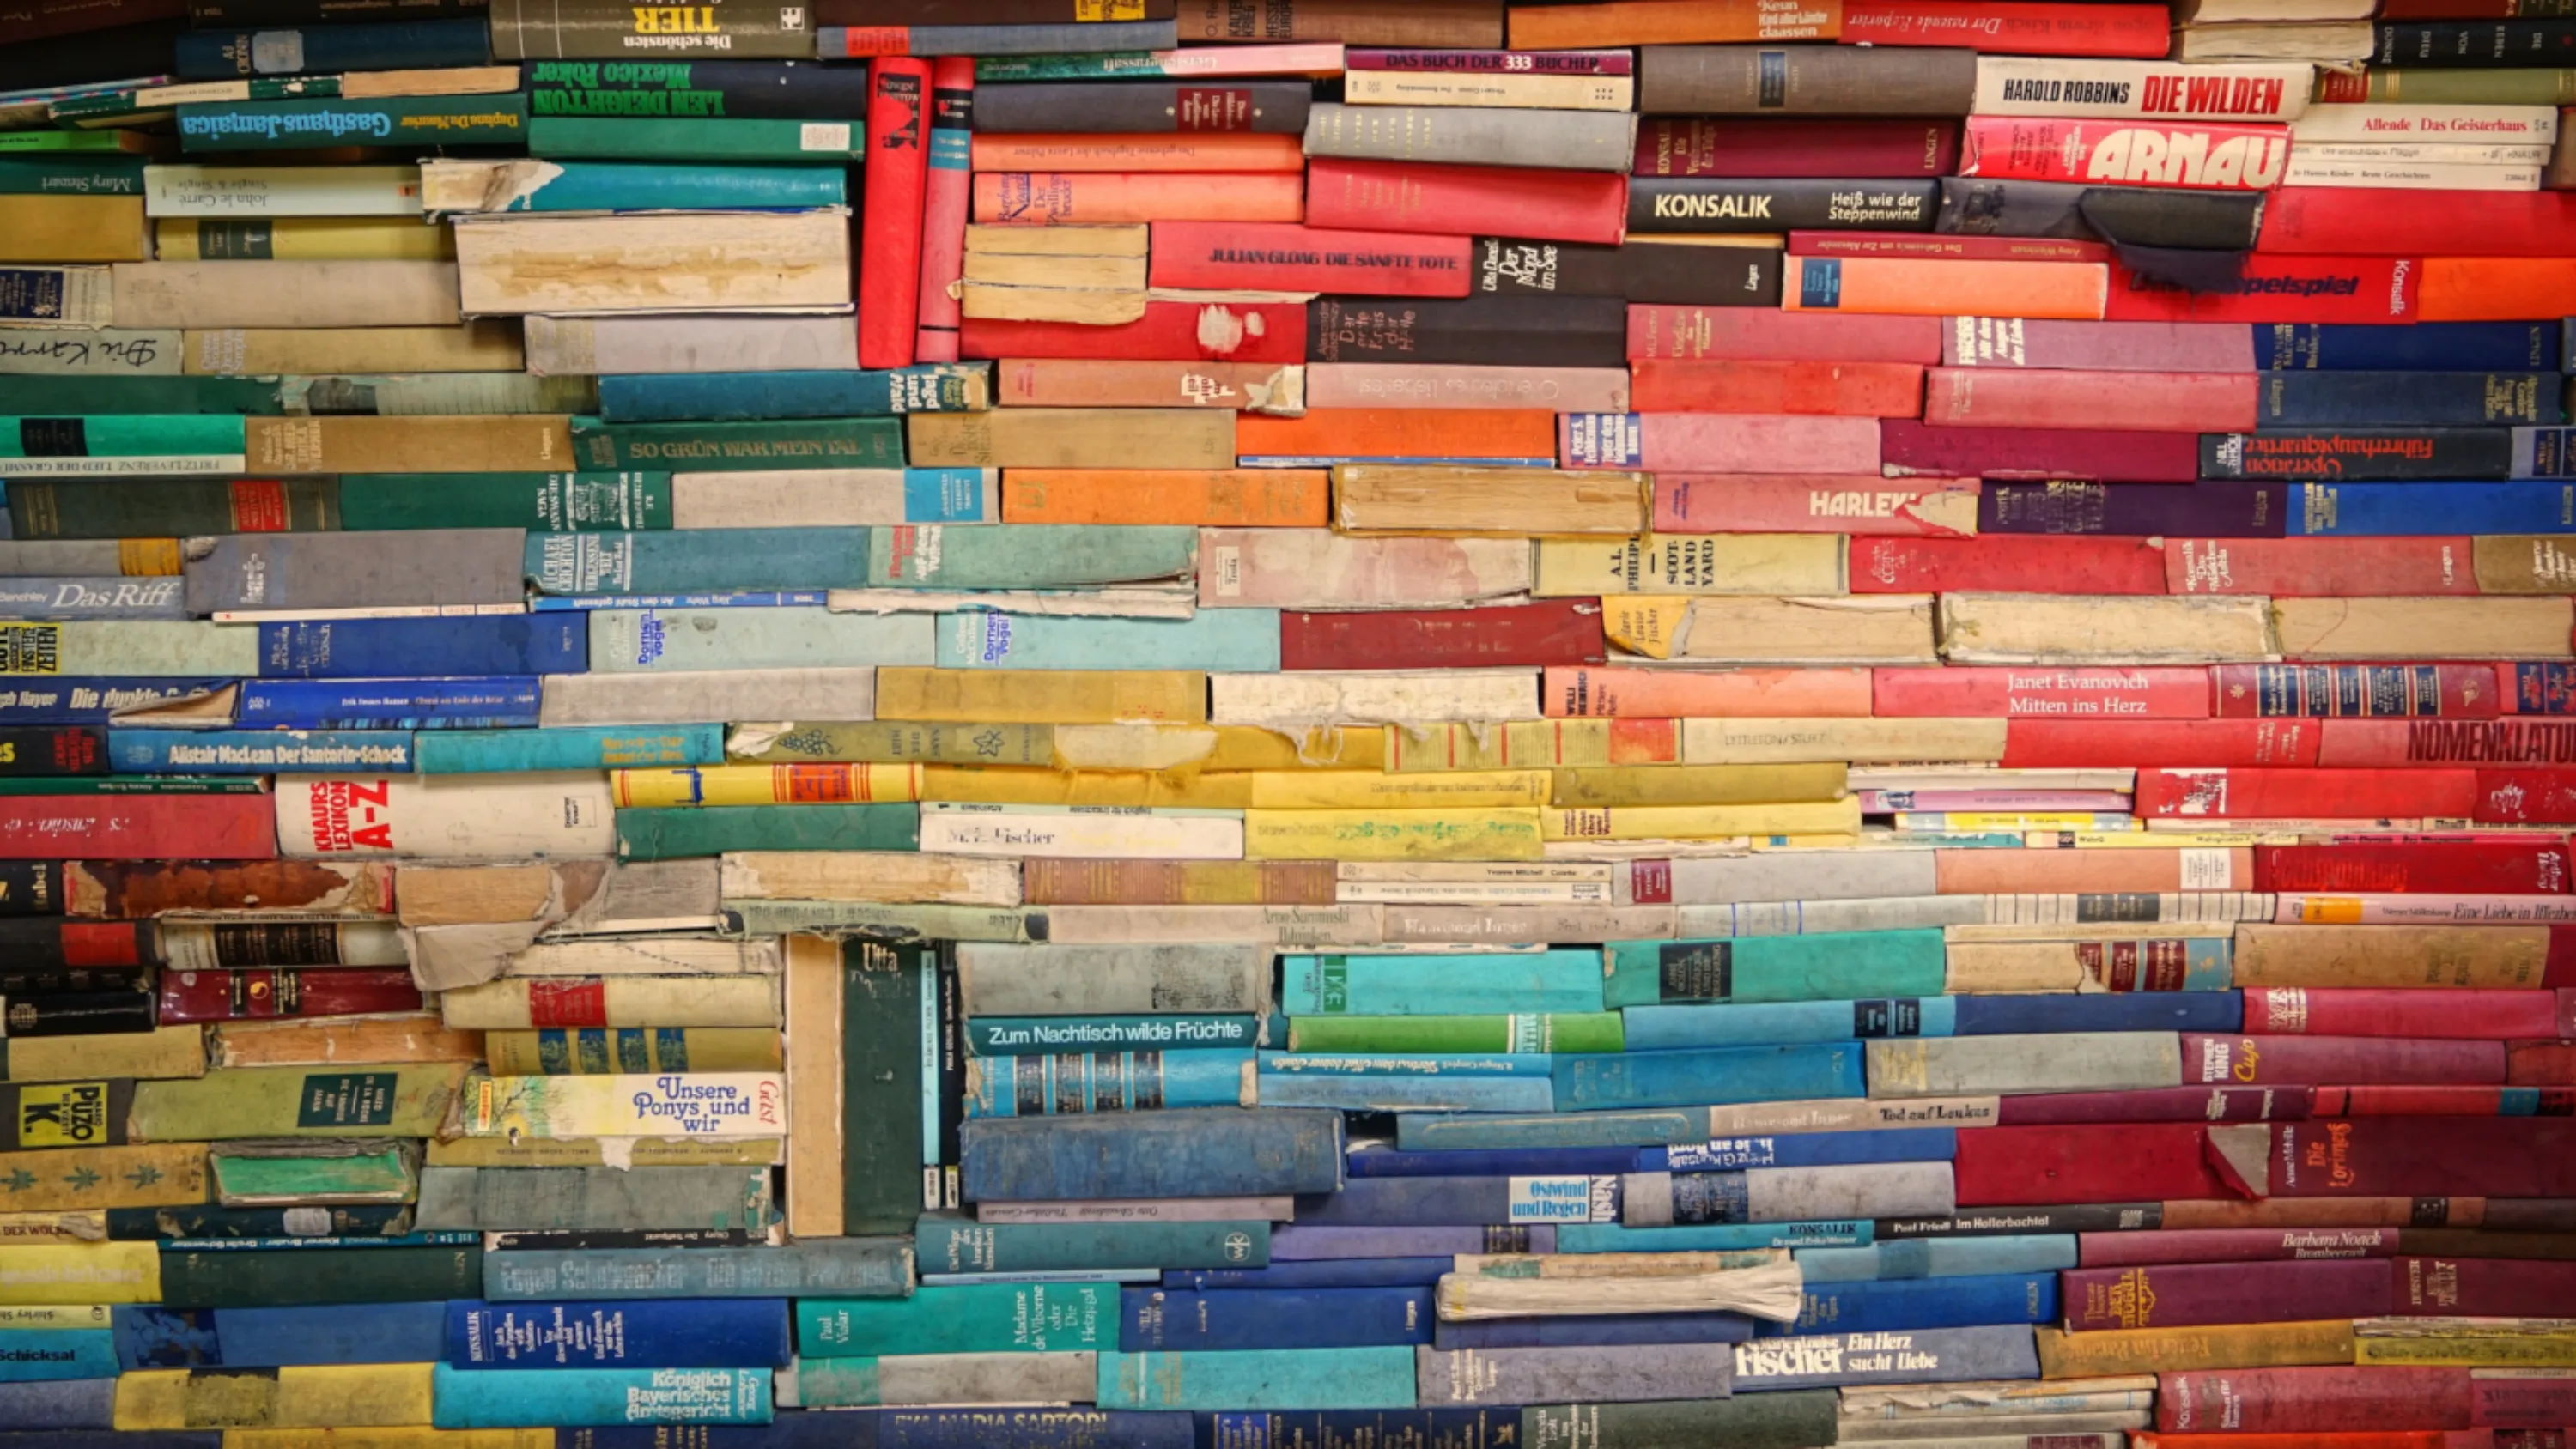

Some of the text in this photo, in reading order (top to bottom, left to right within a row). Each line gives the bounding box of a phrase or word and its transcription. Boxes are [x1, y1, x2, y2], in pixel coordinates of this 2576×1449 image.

[632, 7, 720, 34] TIER
[1758, 26, 1818, 39] claassen
[1917, 15, 1968, 33] rasende
[1972, 16, 2002, 35] Der
[623, 34, 732, 50] Die schönsten
[2457, 31, 2469, 54] VON
[2530, 32, 2543, 50] DIE
[531, 61, 692, 89] Mexico Poker
[1385, 54, 1418, 69] DAS
[1422, 55, 1466, 70] BUCH
[1470, 56, 1502, 70] DER
[1504, 55, 1533, 70] 333
[532, 89, 726, 117] LEN DEIGHTON
[2002, 78, 2061, 104] HAROLD
[2063, 80, 2131, 104] ROBBINS
[2140, 75, 2185, 114] DIE
[2184, 75, 2286, 116] WILDEN
[181, 110, 392, 141] Gasthaus Jamaica
[470, 111, 519, 128] Daphne
[2361, 118, 2528, 133] Allende Das Geisterhaus
[1923, 127, 1937, 169] LINGEN
[2086, 127, 2287, 189] ARNAU
[41, 175, 131, 192] Mary Stewart
[179, 193, 270, 211] John le Carré
[1654, 194, 1773, 220] KONSALIK
[1831, 191, 1923, 209] Heiß wie der
[1828, 206, 1922, 223] Steppenwind
[1498, 247, 1520, 277] Der
[1516, 245, 1539, 287] Mond
[1538, 245, 1558, 270] See
[2389, 260, 2412, 316] Konsalik
[908, 373, 921, 409] und
[920, 373, 939, 409] Jagd
[629, 442, 659, 458] SO
[660, 437, 722, 458] GRÜN
[2244, 435, 2434, 459] Führerhauptquartier
[598, 551, 612, 576] WELT
[1666, 540, 1680, 585] SCOT-
[1684, 541, 1698, 586] LAND
[1701, 539, 1715, 587] YARD
[51, 581, 182, 608] Das Riff
[37, 626, 58, 672] ZEITEN
[983, 610, 997, 662] Dornen
[2007, 671, 2148, 693] Janet Evanovich
[2009, 697, 2147, 714] Mitten ins Herz
[168, 744, 408, 765] Alistair MacLean Der Santorin-Schock
[2406, 720, 2576, 764] NOMENKLATU
[310, 781, 333, 852] KNAURS
[328, 780, 353, 852] LEXIKON
[349, 779, 393, 851] A-Z
[2453, 903, 2483, 920] Eine
[2484, 903, 2517, 920] Liebe
[2519, 903, 2531, 920] in
[861, 941, 898, 973] Utta
[988, 1020, 1243, 1046] Zum Nachtisch wilde Früchte
[2202, 1038, 2215, 1082] STEPHEN
[2214, 1043, 2230, 1079] KING
[2233, 1038, 2260, 1082] Cujo
[656, 1076, 737, 1100] Unsere
[71, 1086, 100, 1142] PUZO
[94, 1100, 103, 1126] MARIO
[633, 1091, 750, 1119] Ponys und
[24, 1103, 60, 1134] K.
[682, 1113, 721, 1133] wir
[2282, 1125, 2296, 1188] Anne Melville
[2306, 1142, 2326, 1167] Die
[1529, 1179, 1588, 1198] Ostwind
[1589, 1174, 1617, 1222] Nash
[1511, 1199, 1588, 1219] und Regen
[1789, 1222, 1856, 1235] KONSALIK
[1956, 1218, 1971, 1230] Im
[1972, 1216, 2050, 1229] Hollerbachtal
[2282, 1231, 2382, 1248] Barbara Noack
[817, 1316, 834, 1340] Paul
[1013, 1291, 1027, 1343] Madame
[1050, 1304, 1062, 1331] oder
[466, 1311, 483, 1361] KONSALIK
[1033, 1336, 1047, 1350] de
[1847, 1333, 1912, 1352] Ein Herz
[0, 1349, 76, 1361] Schicksal
[1735, 1342, 1844, 1377] Fischer
[1848, 1353, 1939, 1373] sucht Liebe
[652, 1368, 732, 1393] Königlich
[627, 1387, 730, 1409] Bayerisches
